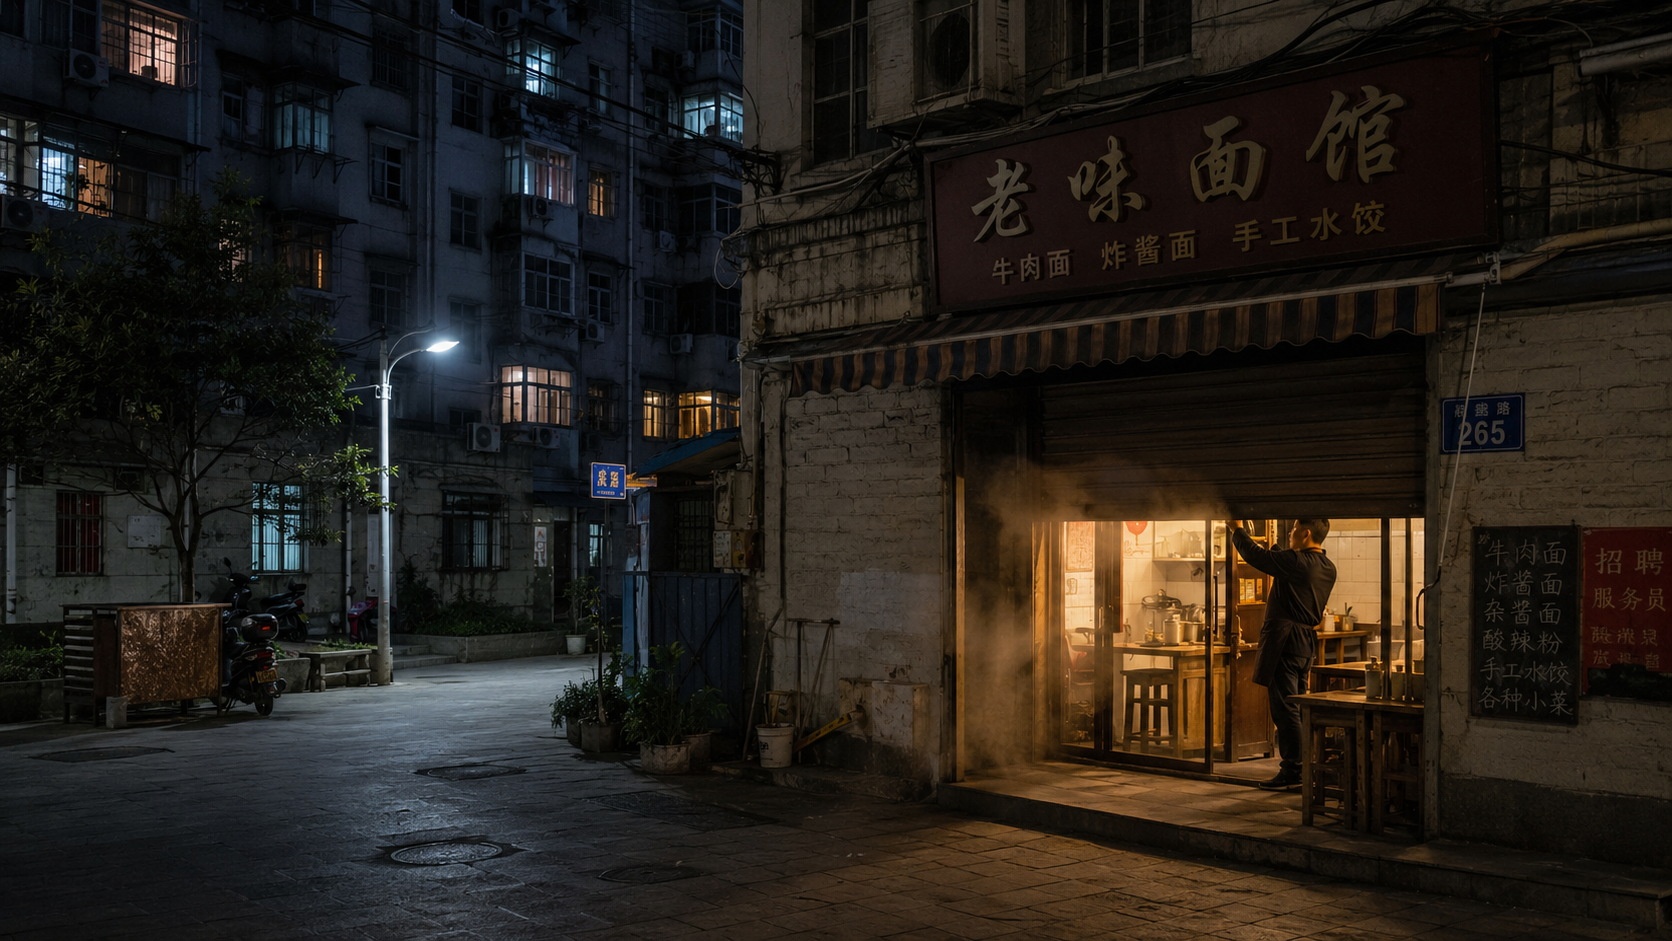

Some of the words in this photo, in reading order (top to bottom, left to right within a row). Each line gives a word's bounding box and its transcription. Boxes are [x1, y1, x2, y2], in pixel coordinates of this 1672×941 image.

[970, 85, 1404, 243] 老味面馆
[992, 249, 1071, 285] 牛肉面
[1102, 230, 1197, 271] 炸酱面
[1232, 201, 1387, 253] 手工水饺
[1458, 420, 1505, 446] 265
[1484, 538, 1566, 566] 牛肉面
[1595, 547, 1664, 575] 招聘
[1592, 586, 1666, 612] 服务员
[1482, 628, 1563, 654] 酸辣粉
[1480, 656, 1572, 686] 手工水饺
[1479, 686, 1573, 716] 各种小菜
